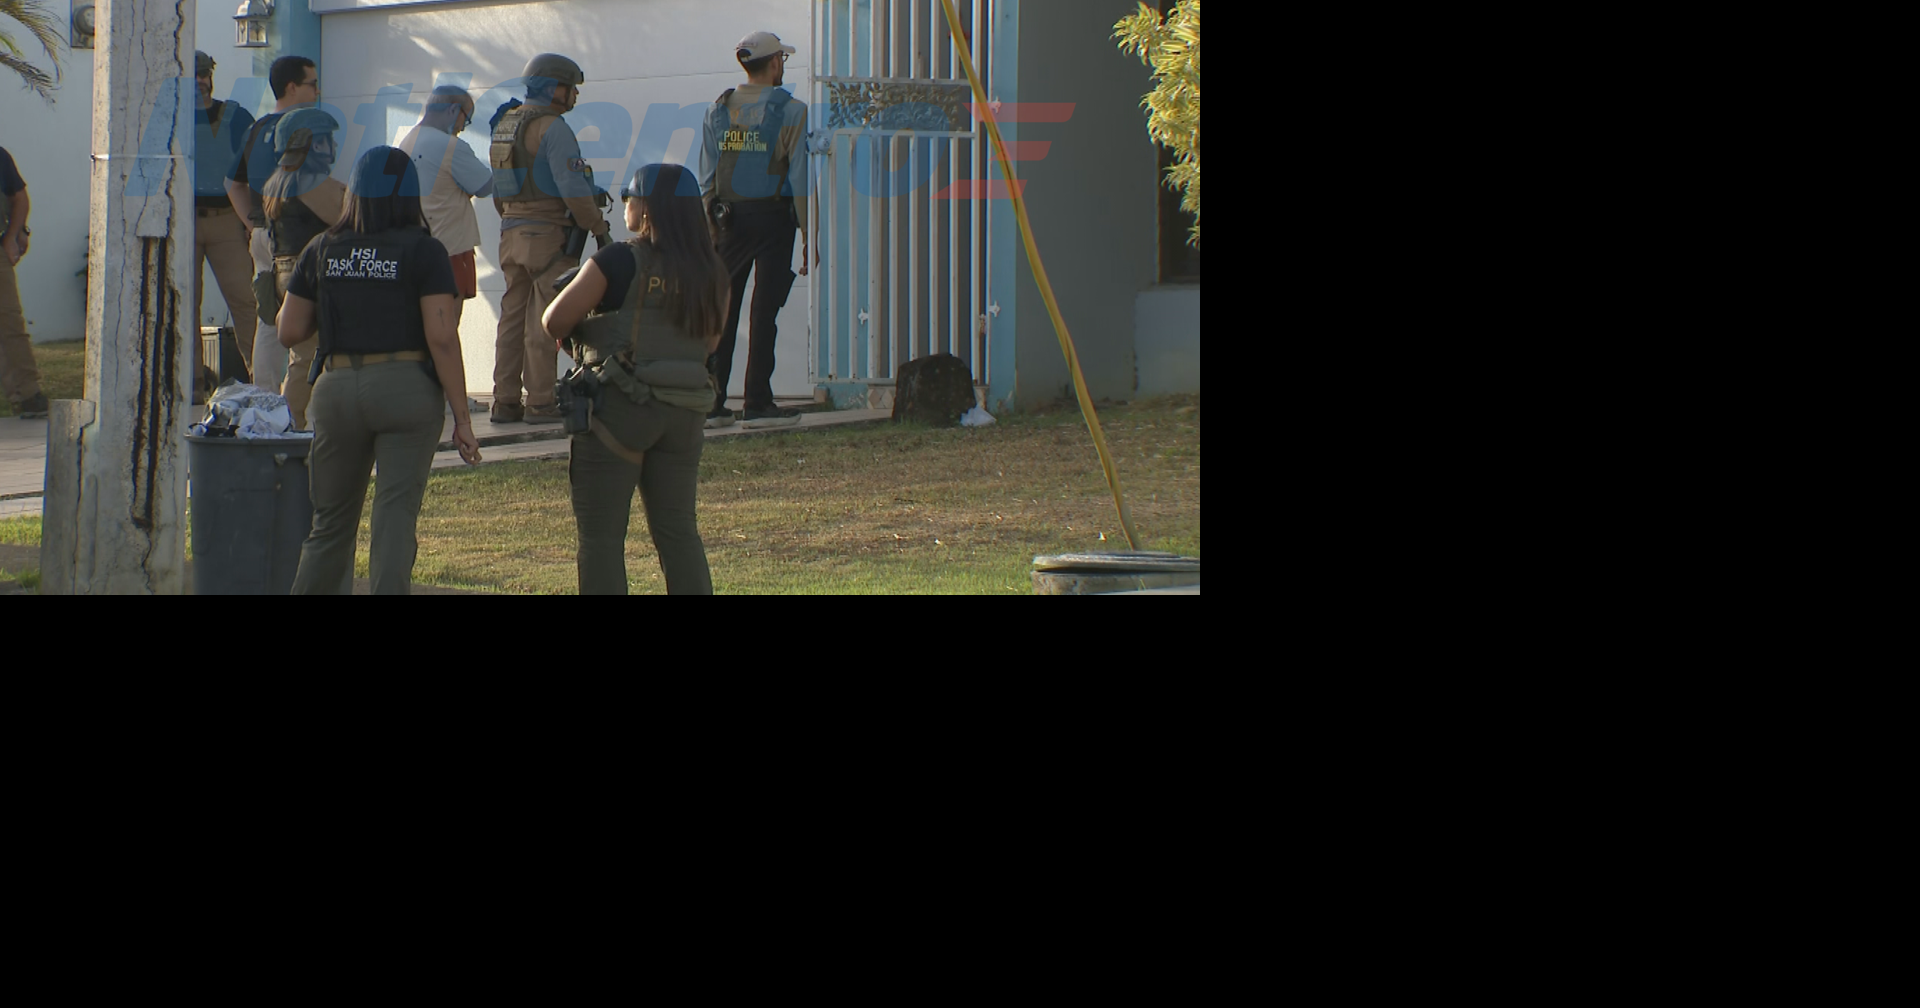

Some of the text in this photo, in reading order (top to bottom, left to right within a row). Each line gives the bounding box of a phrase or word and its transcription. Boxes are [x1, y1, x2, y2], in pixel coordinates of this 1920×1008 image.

[724, 130, 760, 143] POLICE
[718, 141, 767, 152] US PROBATION
[350, 247, 378, 260] HSI
[327, 259, 398, 273] TASK FORCE
